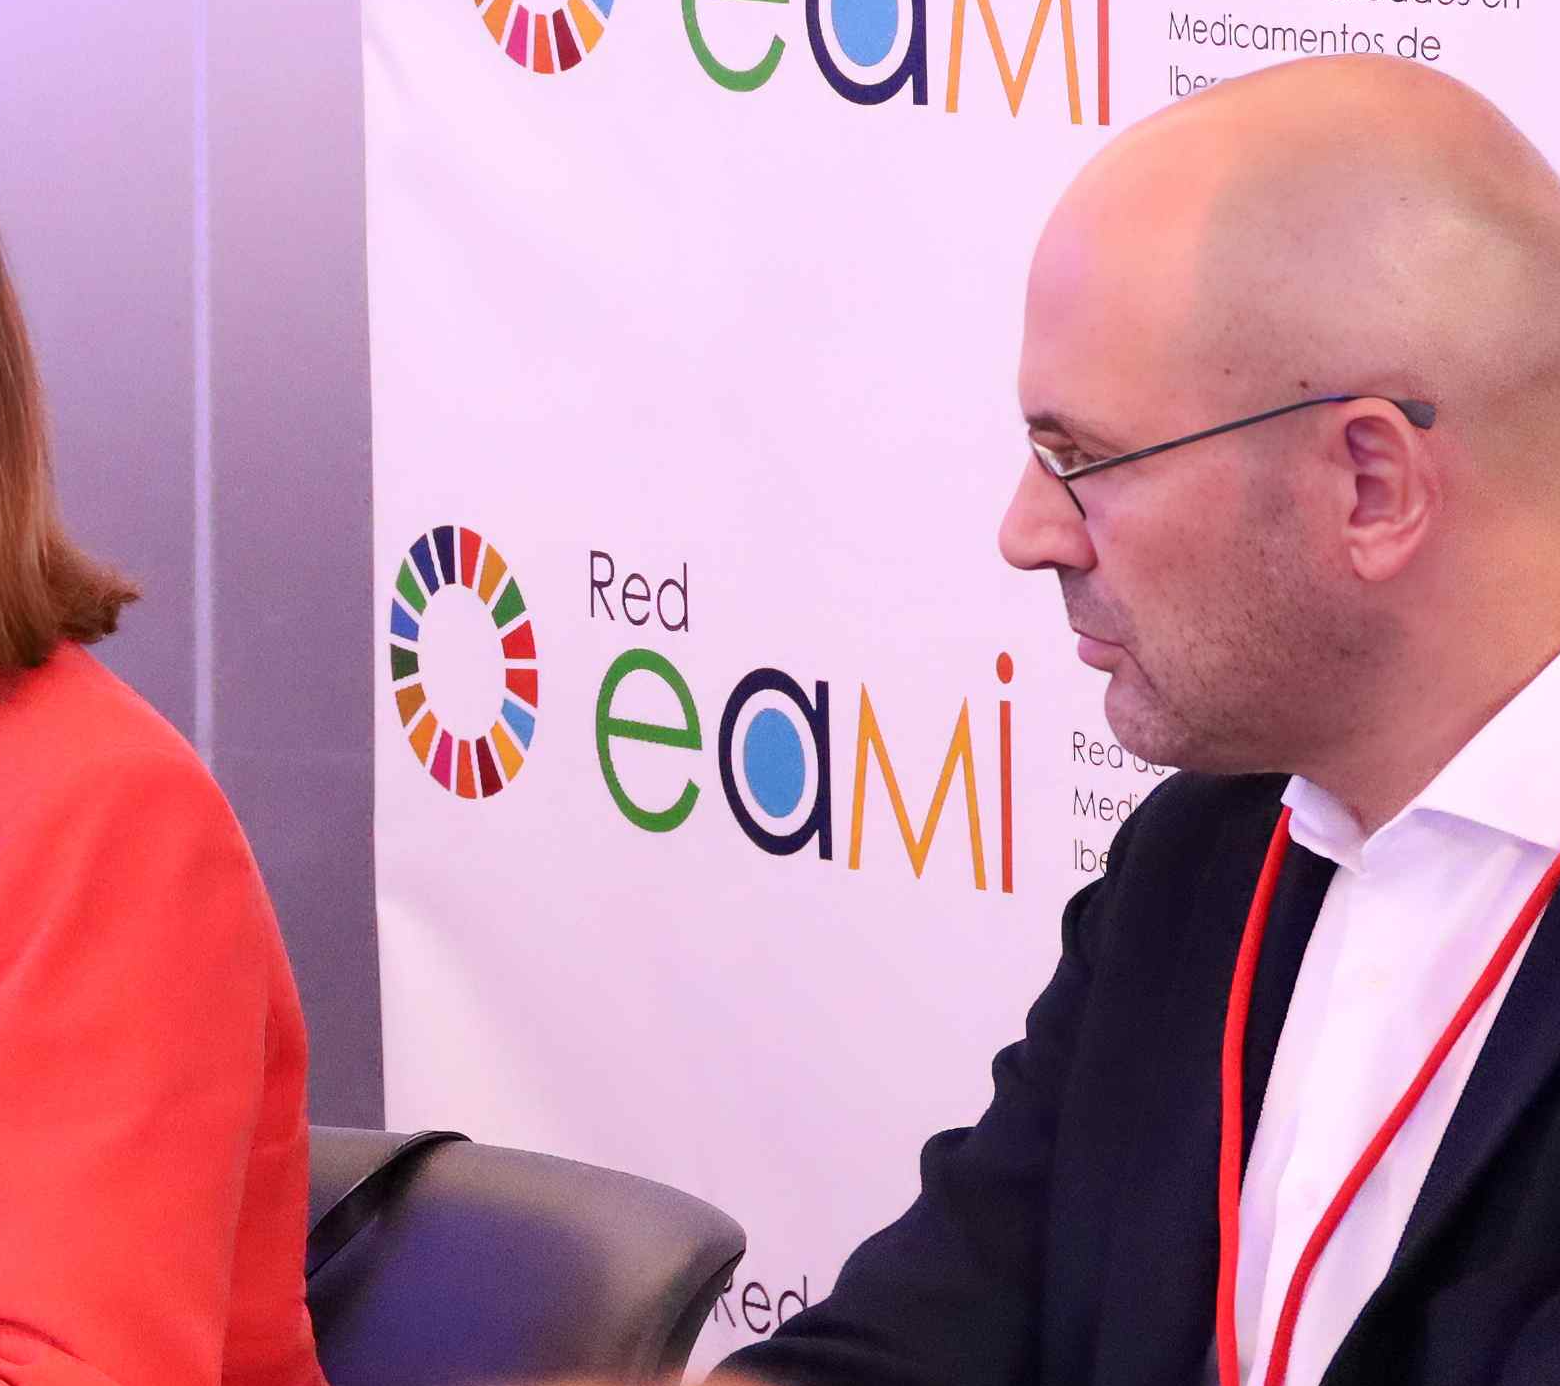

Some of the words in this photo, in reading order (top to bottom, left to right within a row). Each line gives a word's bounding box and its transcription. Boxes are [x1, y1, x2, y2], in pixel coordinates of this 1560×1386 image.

[1169, 12, 1385, 53] Medicamentos
[1397, 27, 1440, 66] de
[590, 550, 688, 632] Red
